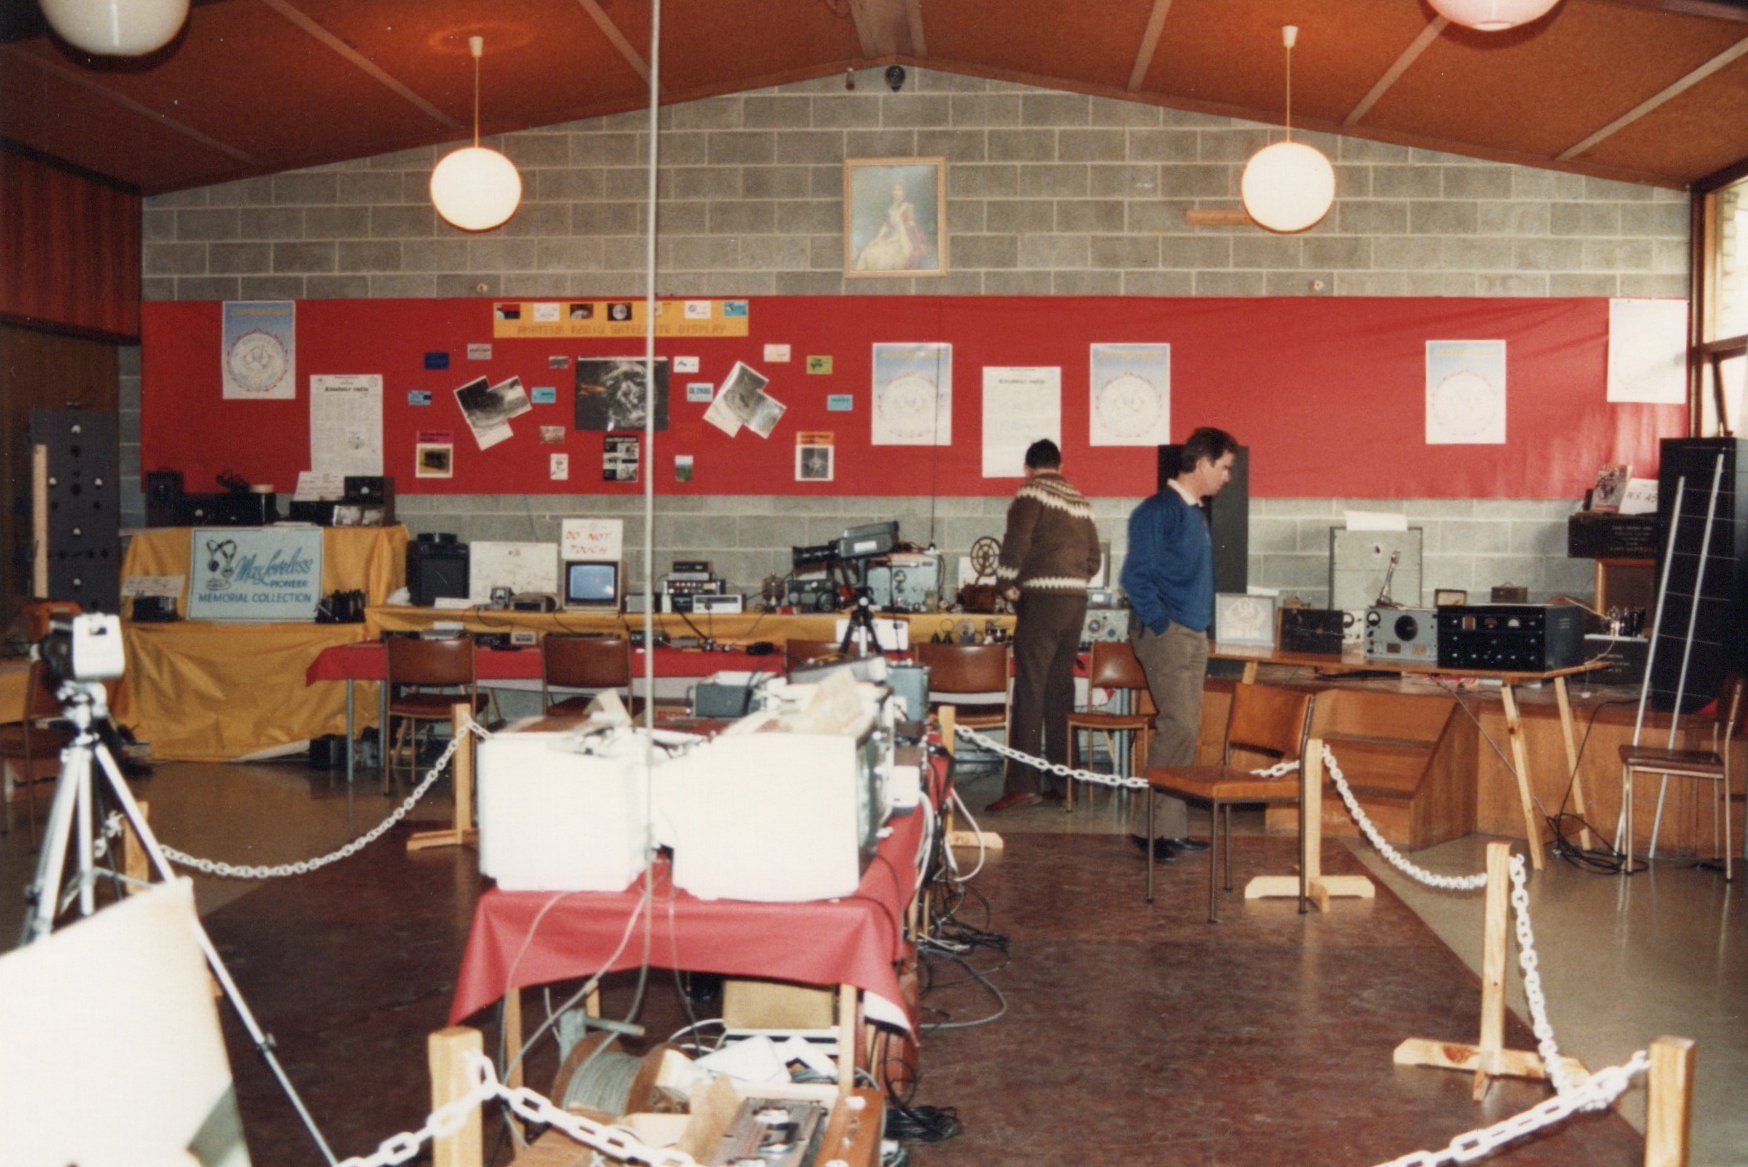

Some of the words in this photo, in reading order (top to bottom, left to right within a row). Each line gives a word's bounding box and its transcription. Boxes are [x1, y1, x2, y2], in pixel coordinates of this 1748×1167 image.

[565, 530, 581, 541] DO
[588, 531, 611, 542] NOT
[570, 544, 608, 554] TOUCH
[270, 579, 308, 588] PIONEER
[198, 592, 249, 604] MEMORIAL
[252, 592, 312, 604] COLLECTION
